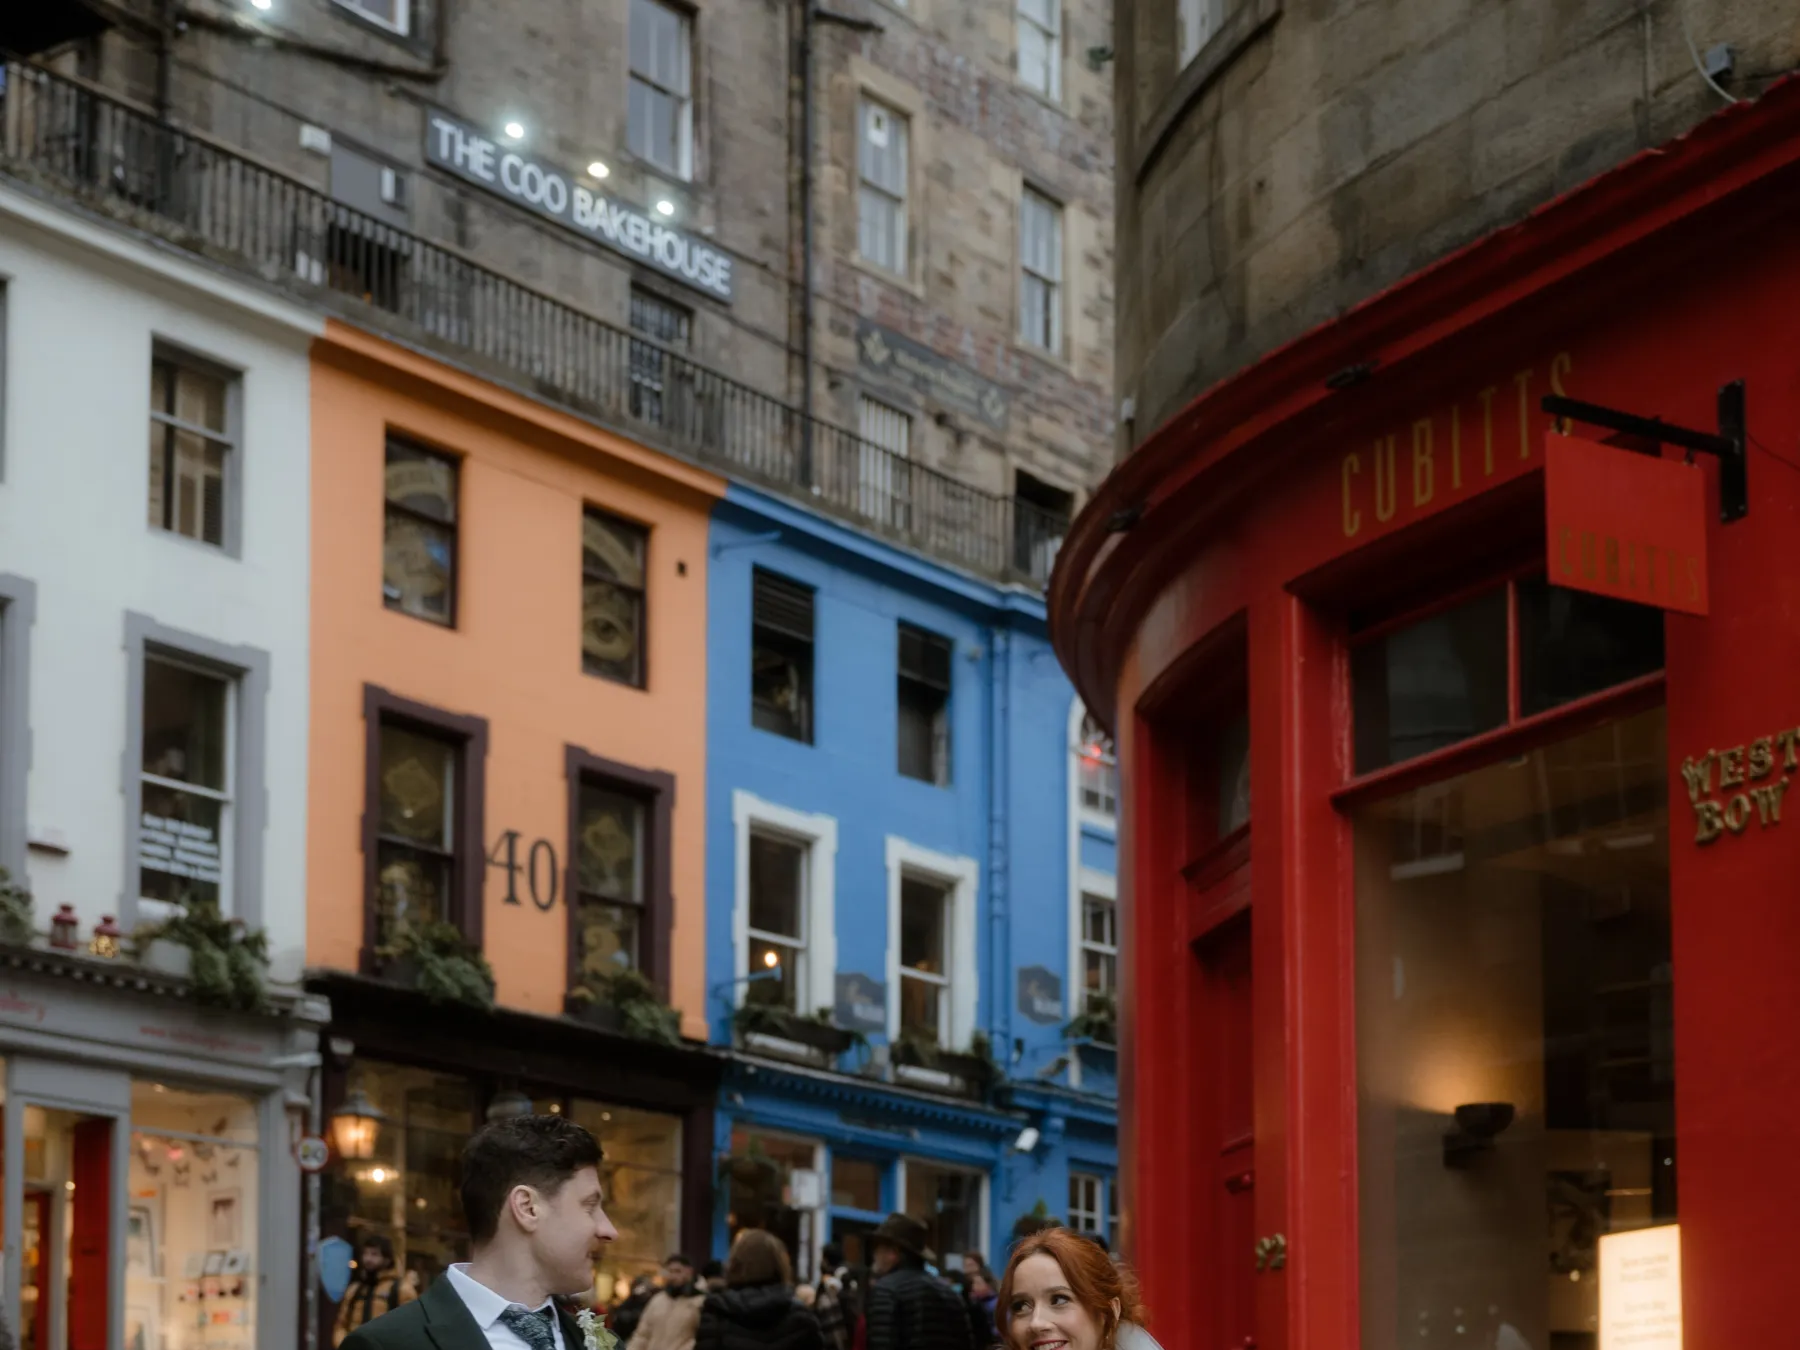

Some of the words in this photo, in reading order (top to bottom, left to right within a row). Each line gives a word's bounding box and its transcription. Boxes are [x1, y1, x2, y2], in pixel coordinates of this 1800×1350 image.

[432, 117, 495, 182] THE
[500, 153, 567, 214] COO
[572, 186, 731, 295] BAKEHOUSE
[1341, 351, 1574, 537] CUBITTS
[1558, 524, 1700, 602] CUBITTS
[1681, 725, 1800, 804] WEST
[1693, 776, 1789, 843] BOW
[484, 829, 557, 912] 40
